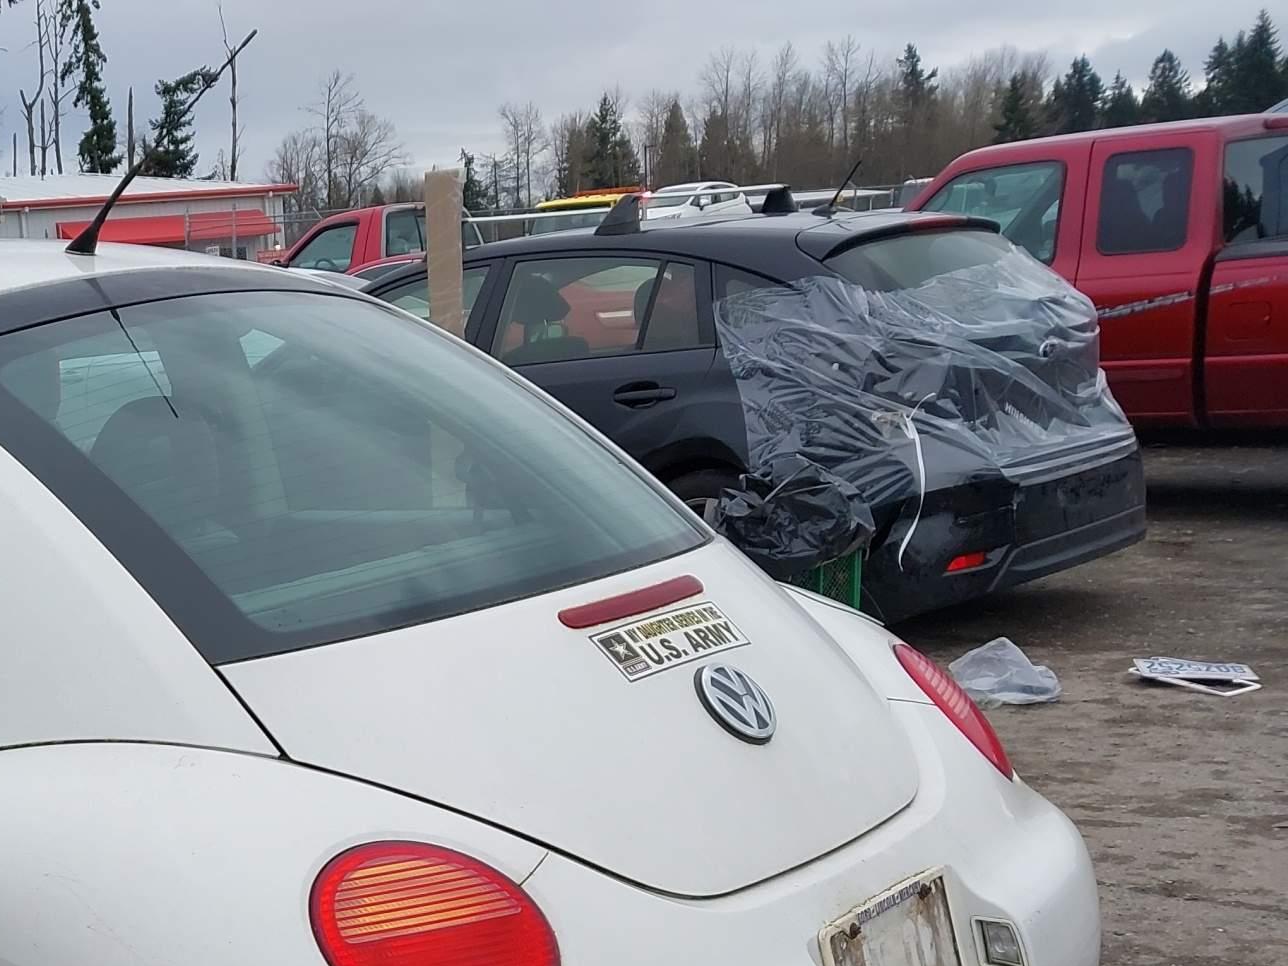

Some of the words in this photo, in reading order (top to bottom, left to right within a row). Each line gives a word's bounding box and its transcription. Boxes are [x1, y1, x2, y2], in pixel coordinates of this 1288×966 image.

[636, 617, 678, 639] DAUGHTER
[639, 638, 690, 665] U.S.
[683, 620, 739, 653] ARMY
